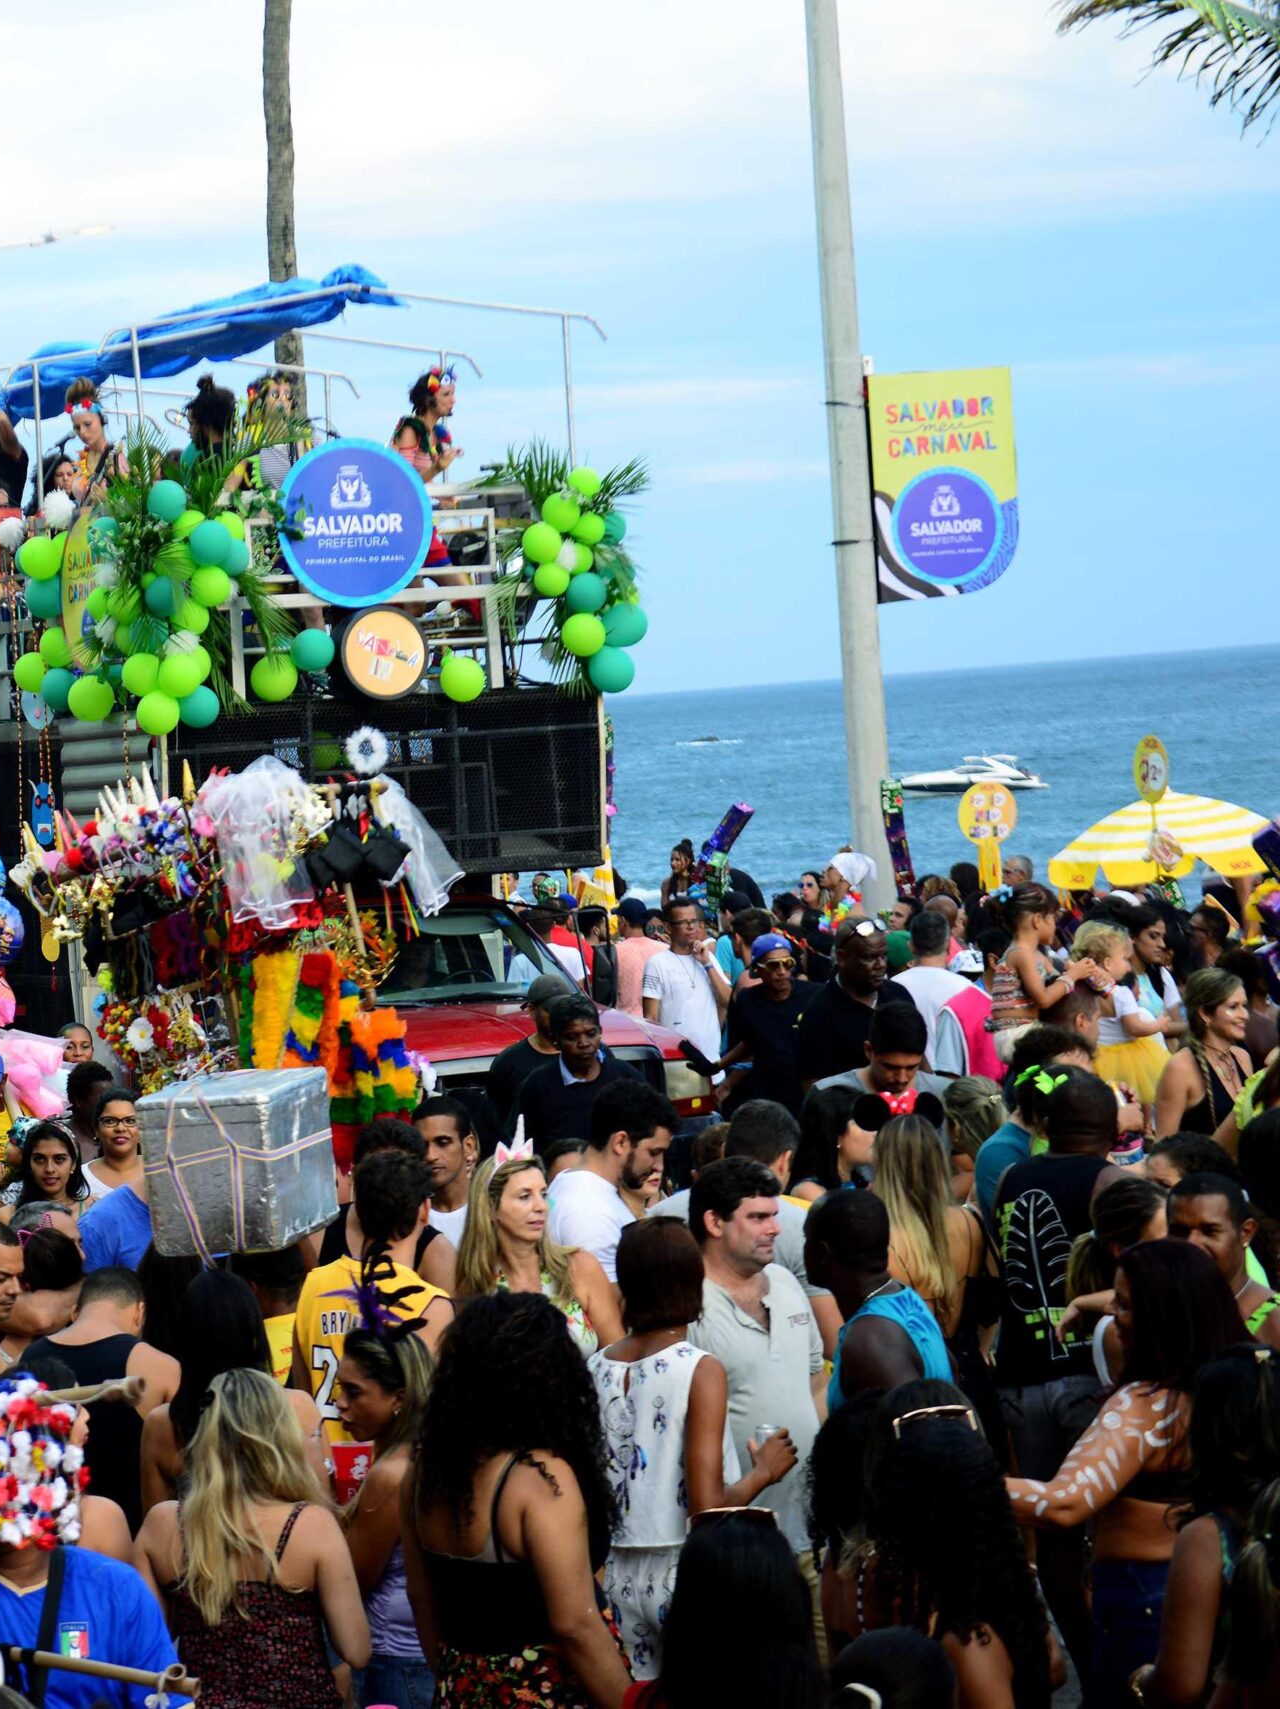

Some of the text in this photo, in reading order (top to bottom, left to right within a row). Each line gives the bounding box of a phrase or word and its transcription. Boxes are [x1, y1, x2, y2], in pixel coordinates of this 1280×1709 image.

[886, 396, 994, 424] SALVADOR
[888, 431, 997, 458] CARNAVAL
[303, 512, 403, 537] SALVADOR
[910, 518, 983, 537] SALVADOR
[318, 535, 389, 549] PREFEITURA
[339, 556, 368, 564] CAPITAL
[381, 554, 406, 562] BRASIL
